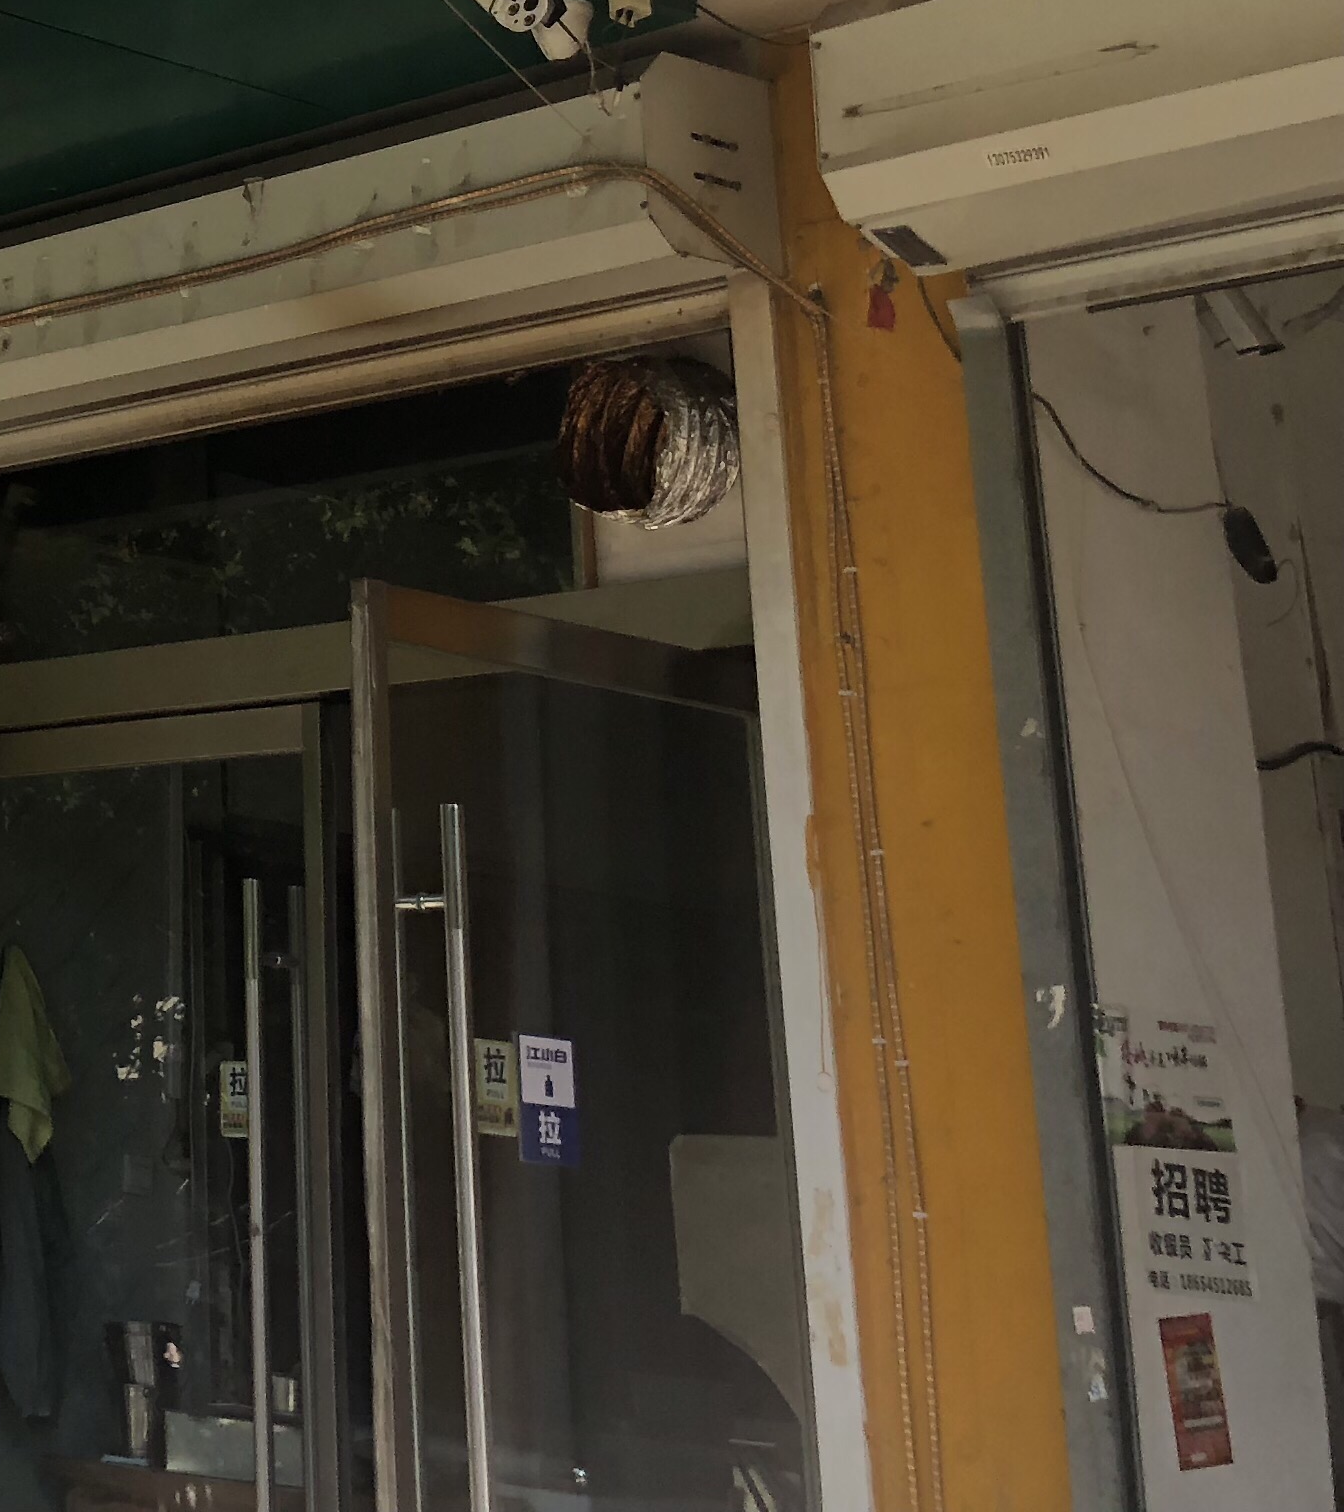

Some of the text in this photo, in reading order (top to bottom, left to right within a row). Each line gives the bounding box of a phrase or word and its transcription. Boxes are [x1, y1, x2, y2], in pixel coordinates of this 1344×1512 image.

[484, 1047, 506, 1084] 拉
[526, 1045, 568, 1064] 江小白
[230, 1067, 248, 1096] 拉
[538, 1110, 562, 1145] 拉
[1151, 1158, 1231, 1225] 招聘
